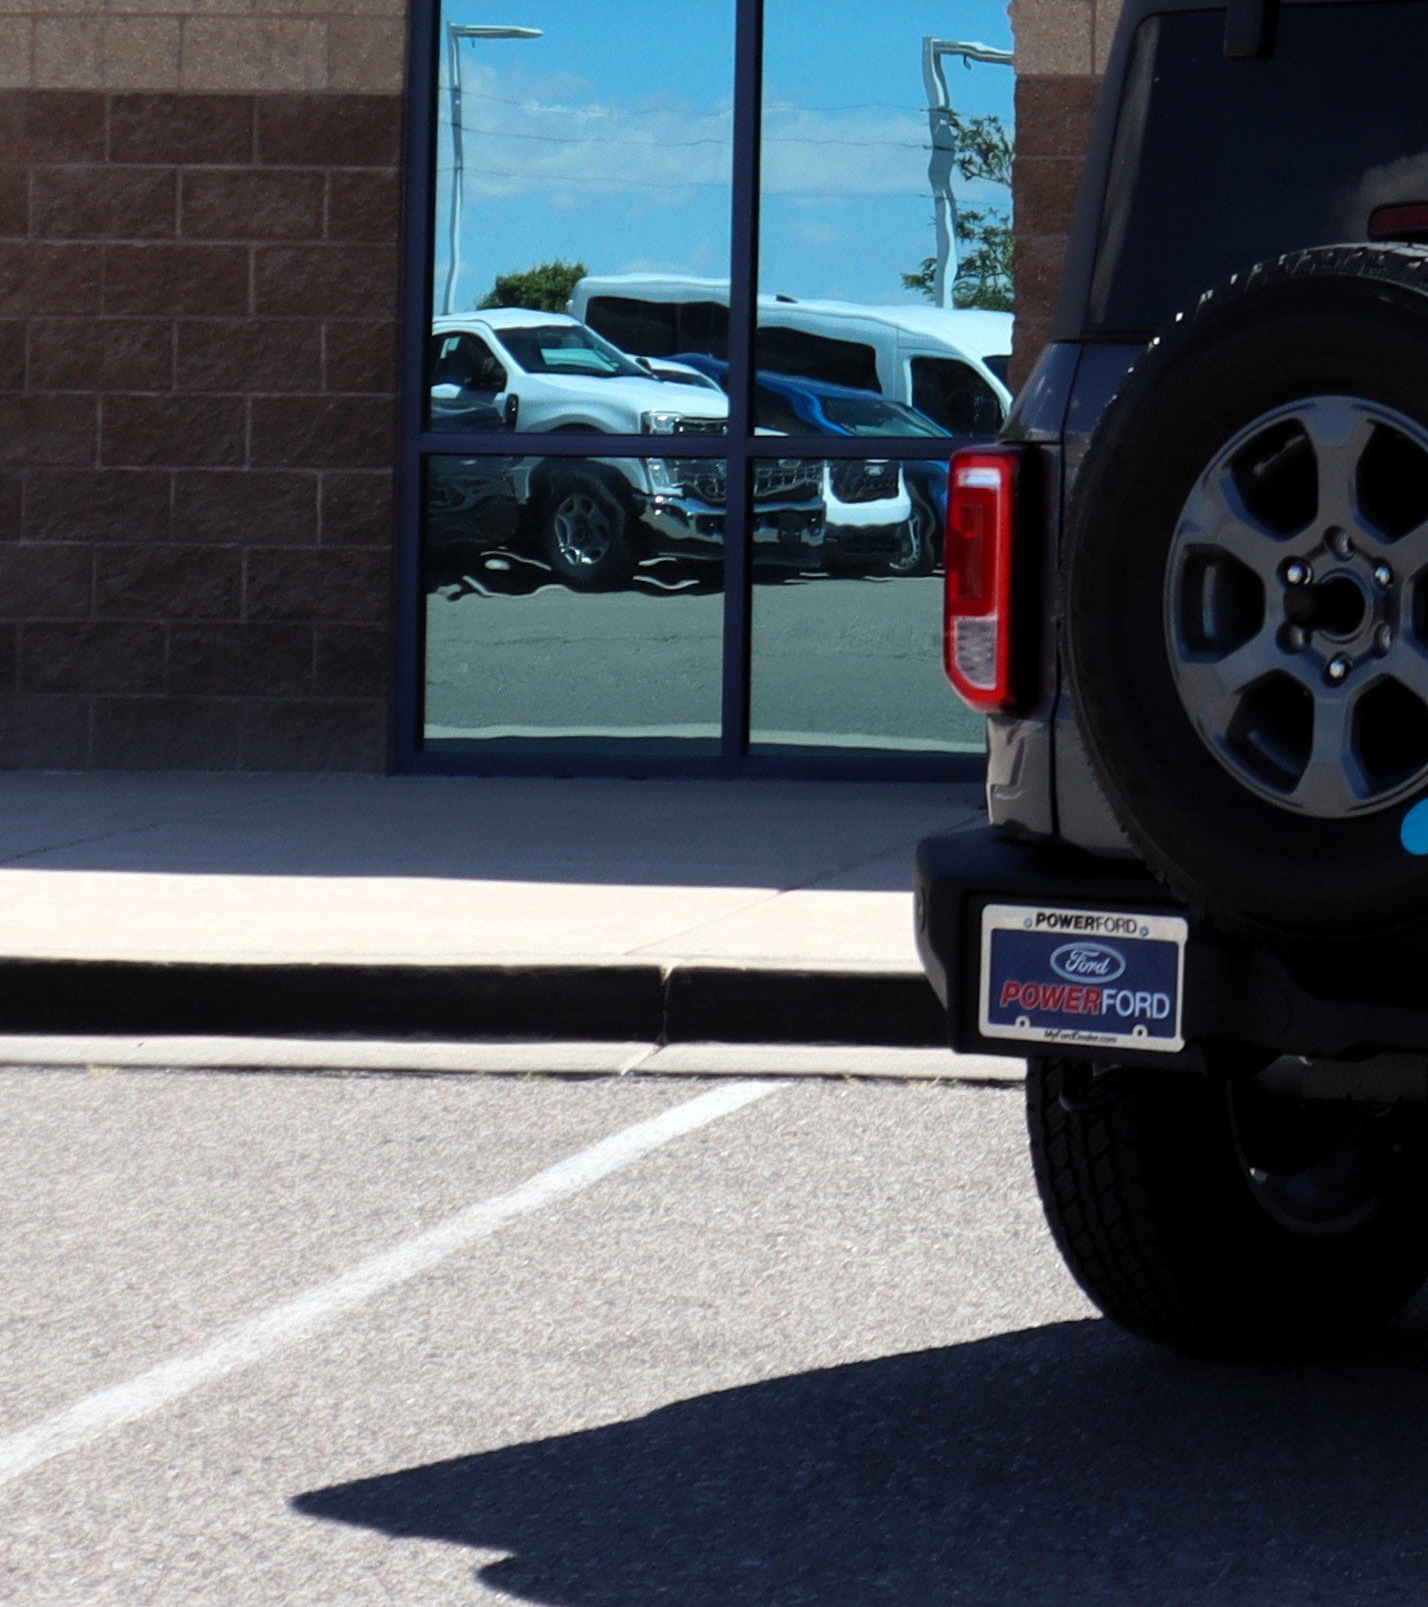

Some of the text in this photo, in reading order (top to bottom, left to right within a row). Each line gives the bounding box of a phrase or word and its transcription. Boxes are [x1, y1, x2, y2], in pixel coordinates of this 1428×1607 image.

[1035, 912, 1137, 934] POWERFORD
[1065, 949, 1110, 974] Ford
[1000, 980, 1171, 1019] POWERFORD
